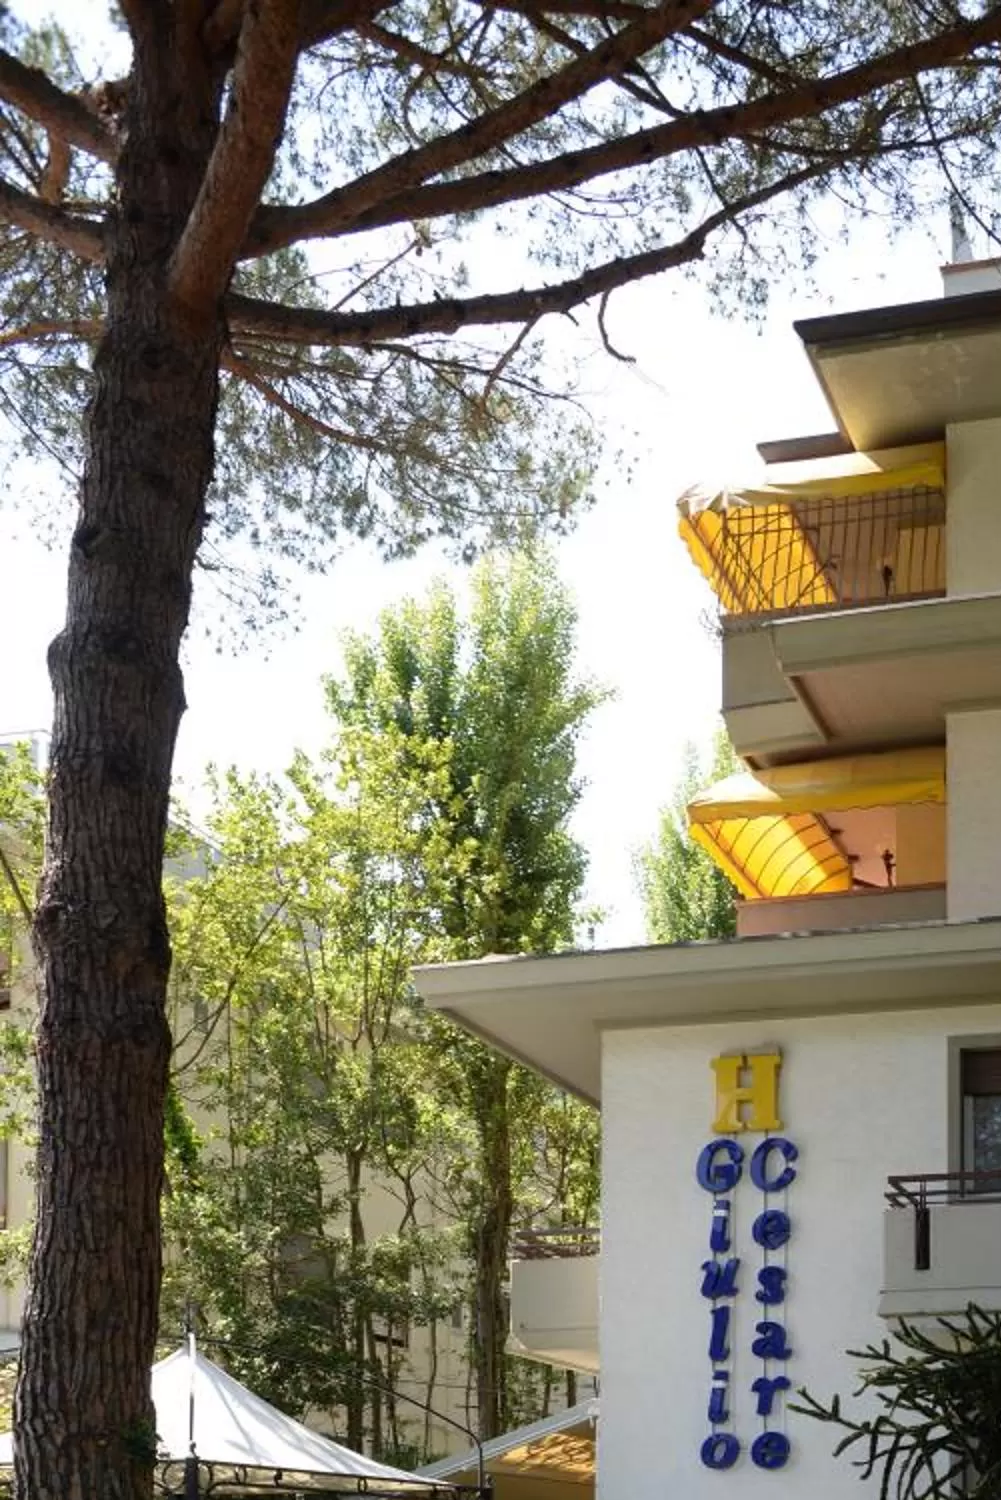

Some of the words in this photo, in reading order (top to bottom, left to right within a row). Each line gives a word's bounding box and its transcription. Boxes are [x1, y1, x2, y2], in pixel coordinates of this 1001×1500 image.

[711, 1054, 782, 1132] H
[696, 1138, 744, 1470] Giulio
[750, 1137, 798, 1470] Cesare
